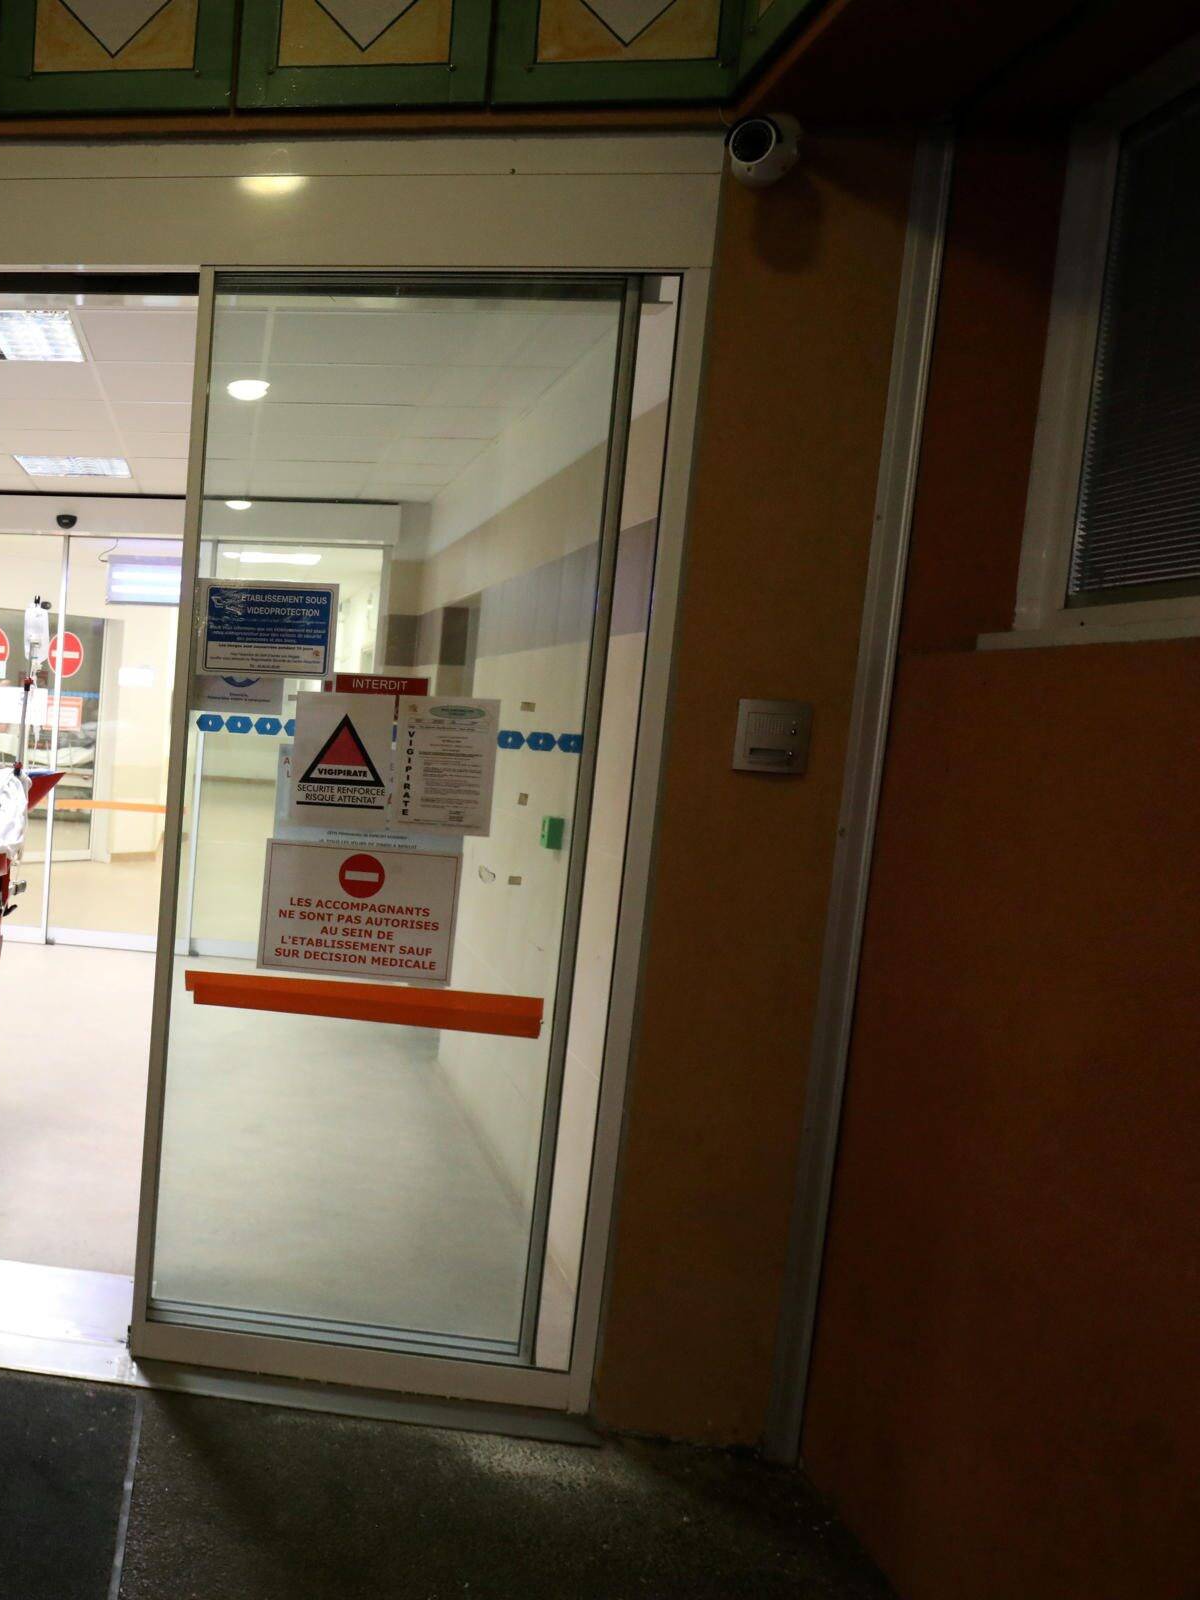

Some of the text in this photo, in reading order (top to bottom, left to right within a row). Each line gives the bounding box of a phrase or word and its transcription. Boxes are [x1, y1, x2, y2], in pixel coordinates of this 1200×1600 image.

[305, 596, 328, 605] SOUS
[246, 607, 320, 617] VIDEOPROTECTION
[352, 678, 408, 691] INTERDIT
[317, 767, 368, 778] VIGIPIRATE
[402, 730, 416, 816] VIGIPIRATE
[297, 783, 386, 797] SECURITE RENFORCEE
[305, 793, 377, 805] RISQUE ATTENTAT
[289, 896, 431, 917] LES ACCOMPAGNANTS
[278, 909, 440, 931] NE SONT PAS AUTORISES
[320, 925, 394, 941] AU SEIN DE
[280, 935, 433, 957] L'ETABLISSEMENT SAUF
[274, 947, 437, 971] SUR DECISION MEDICALE
